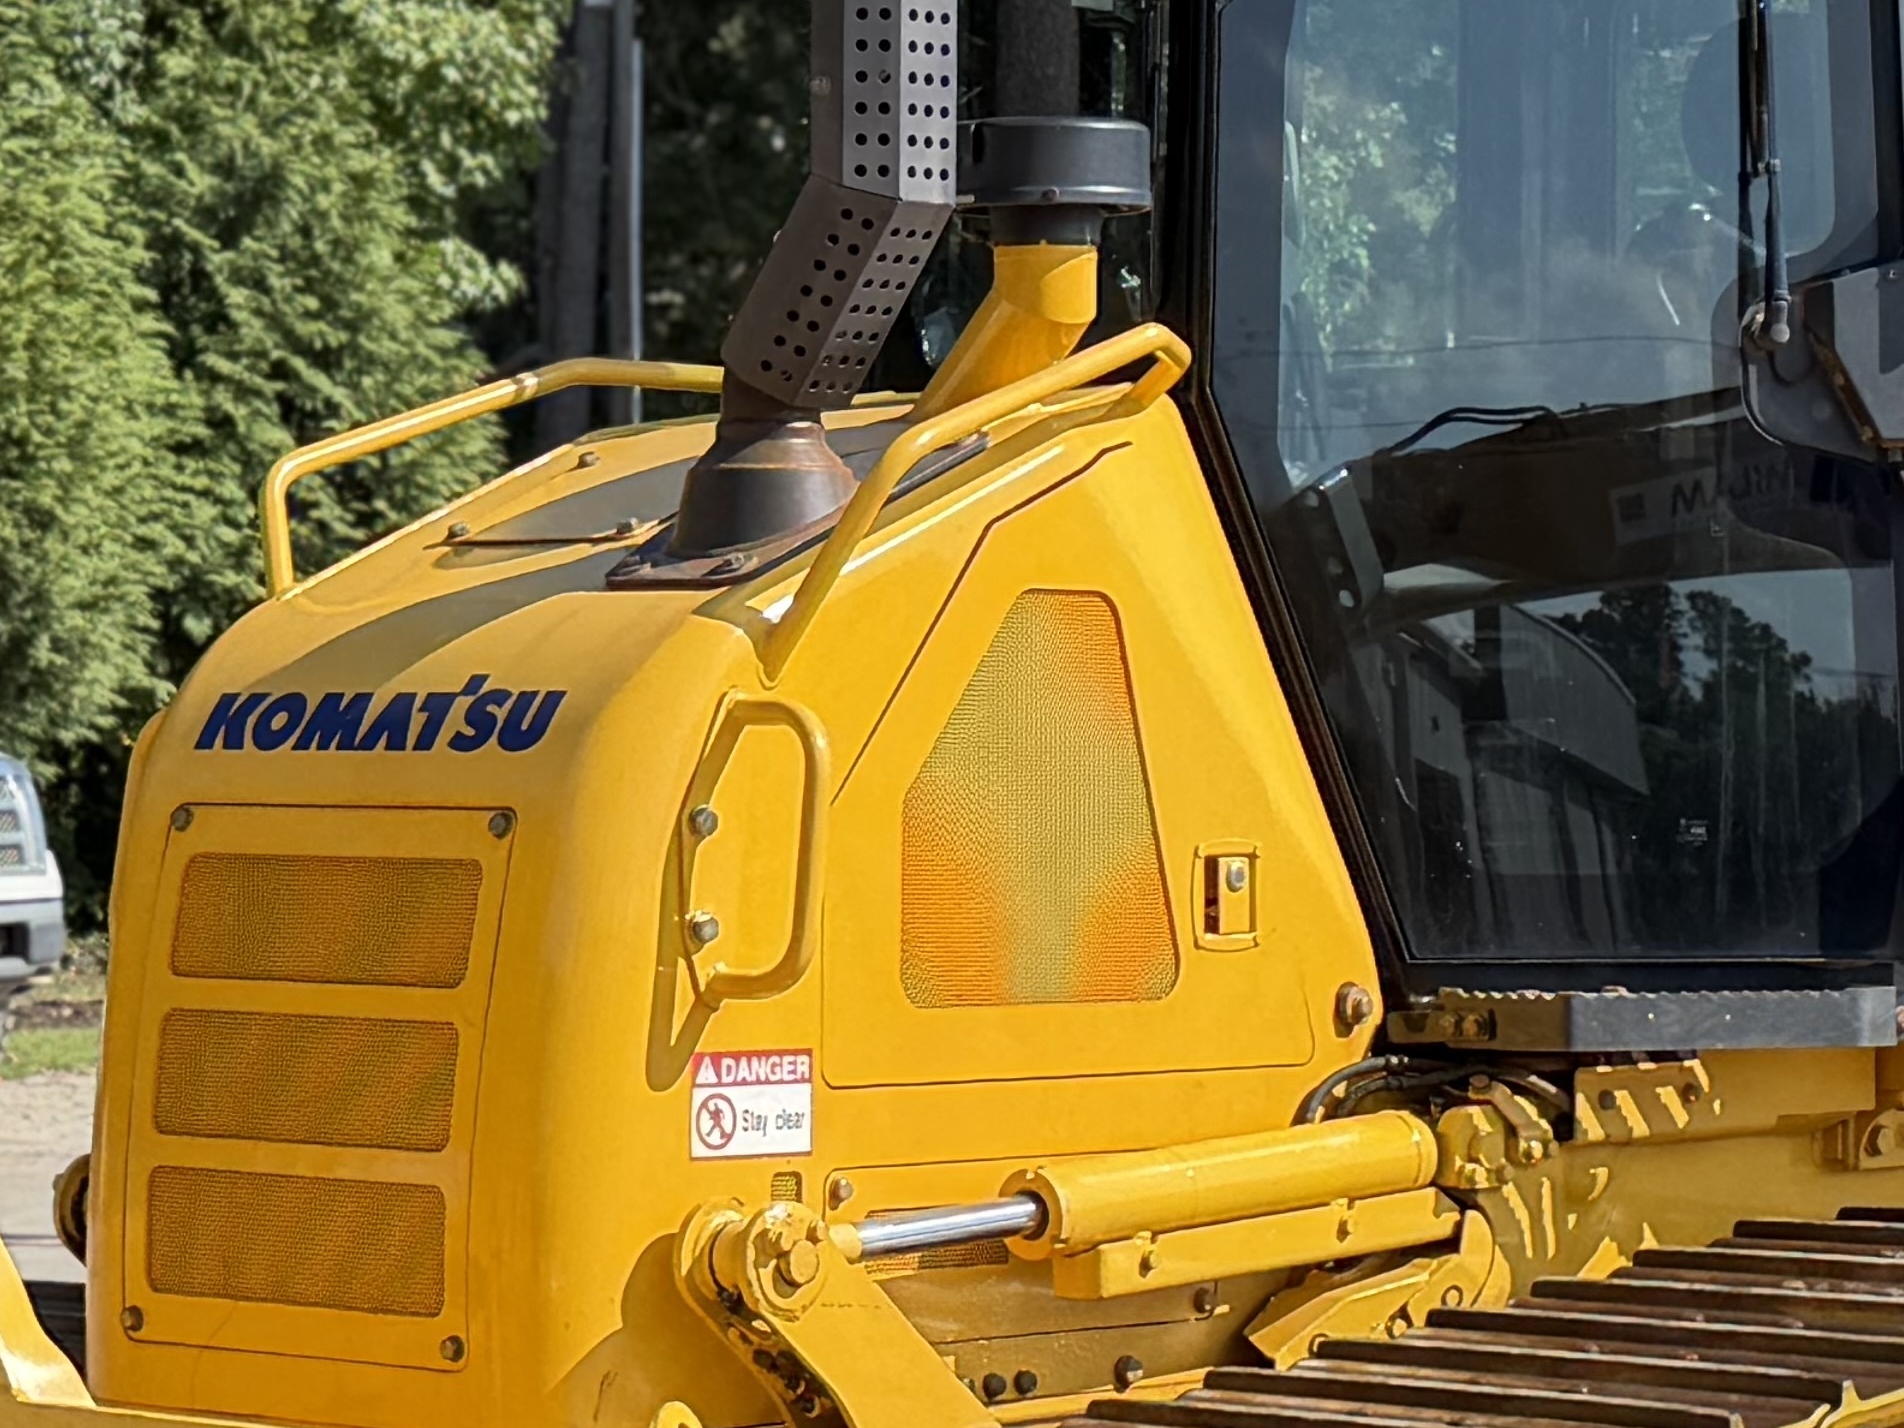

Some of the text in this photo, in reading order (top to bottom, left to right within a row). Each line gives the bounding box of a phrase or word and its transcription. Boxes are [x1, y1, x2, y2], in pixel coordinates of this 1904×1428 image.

[193, 673, 568, 752] KOMATSU
[720, 1054, 810, 1084] DANGER
[741, 1107, 805, 1138] Stay clear
